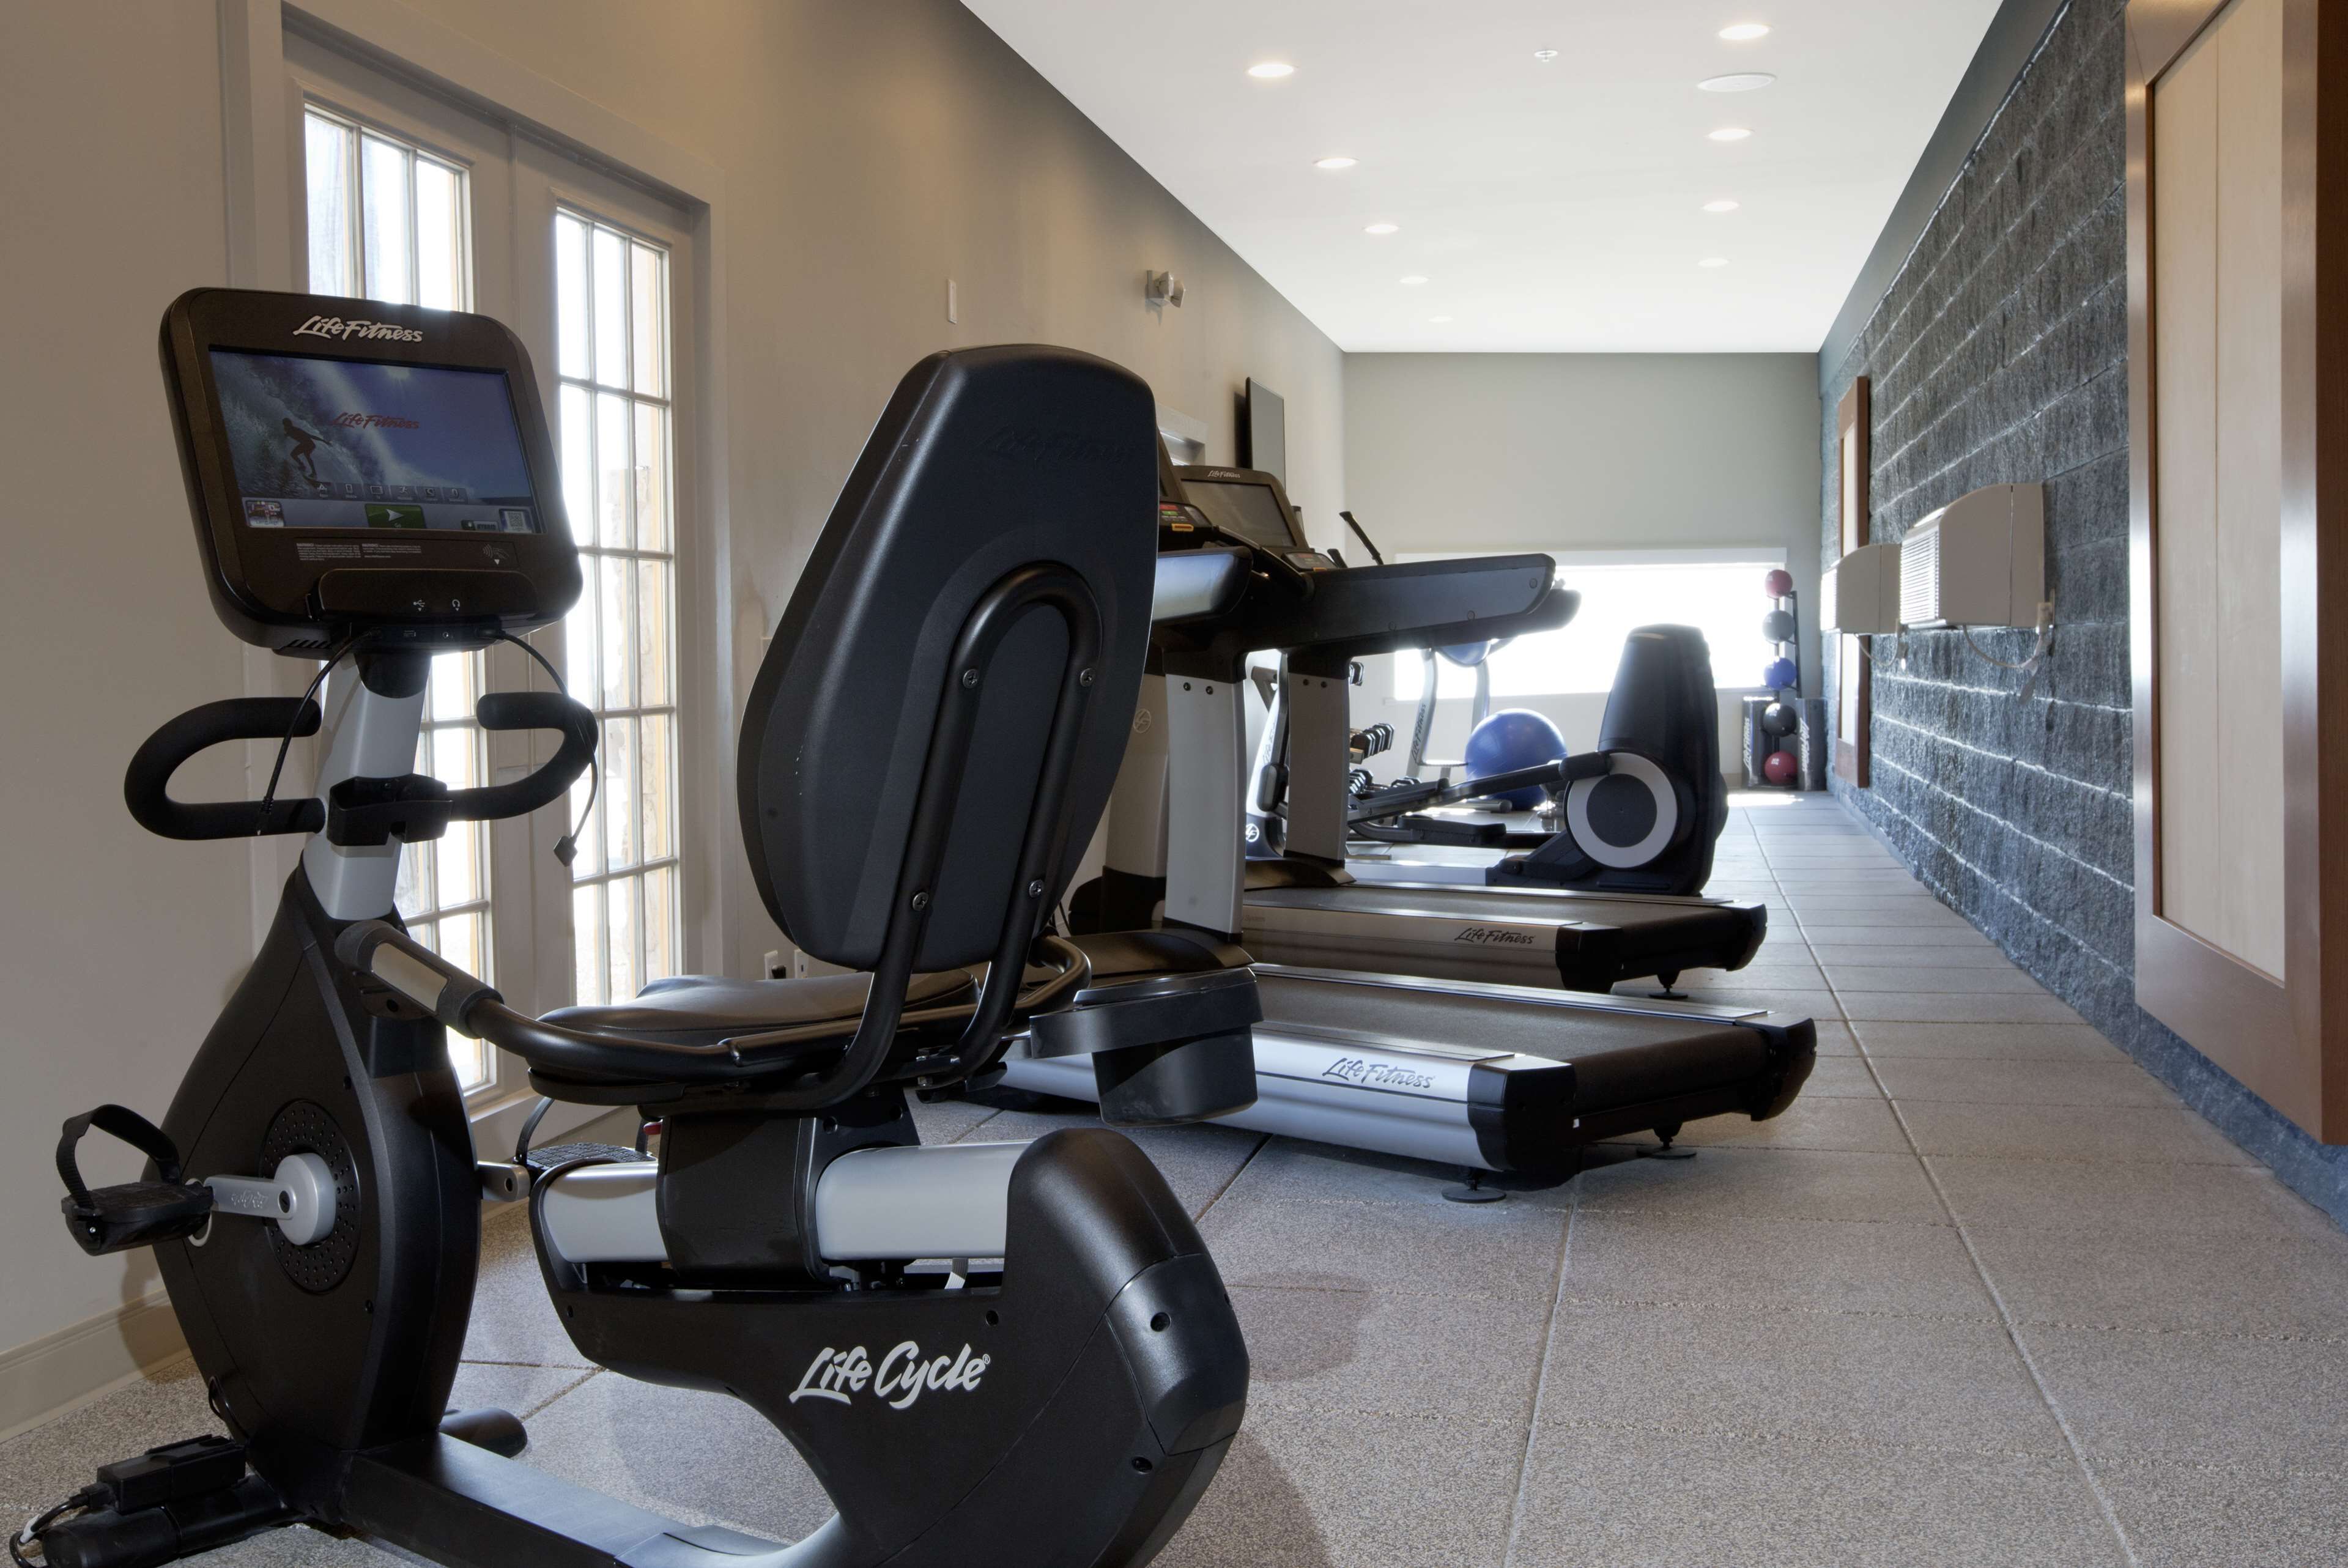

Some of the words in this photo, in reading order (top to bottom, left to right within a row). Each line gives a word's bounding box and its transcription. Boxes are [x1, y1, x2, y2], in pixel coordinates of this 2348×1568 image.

[292, 316, 344, 339] Life
[342, 320, 423, 342] Fitness
[1322, 1057, 1364, 1081] Life
[1361, 1066, 1434, 1089] Fitness
[788, 1345, 873, 1405] Life
